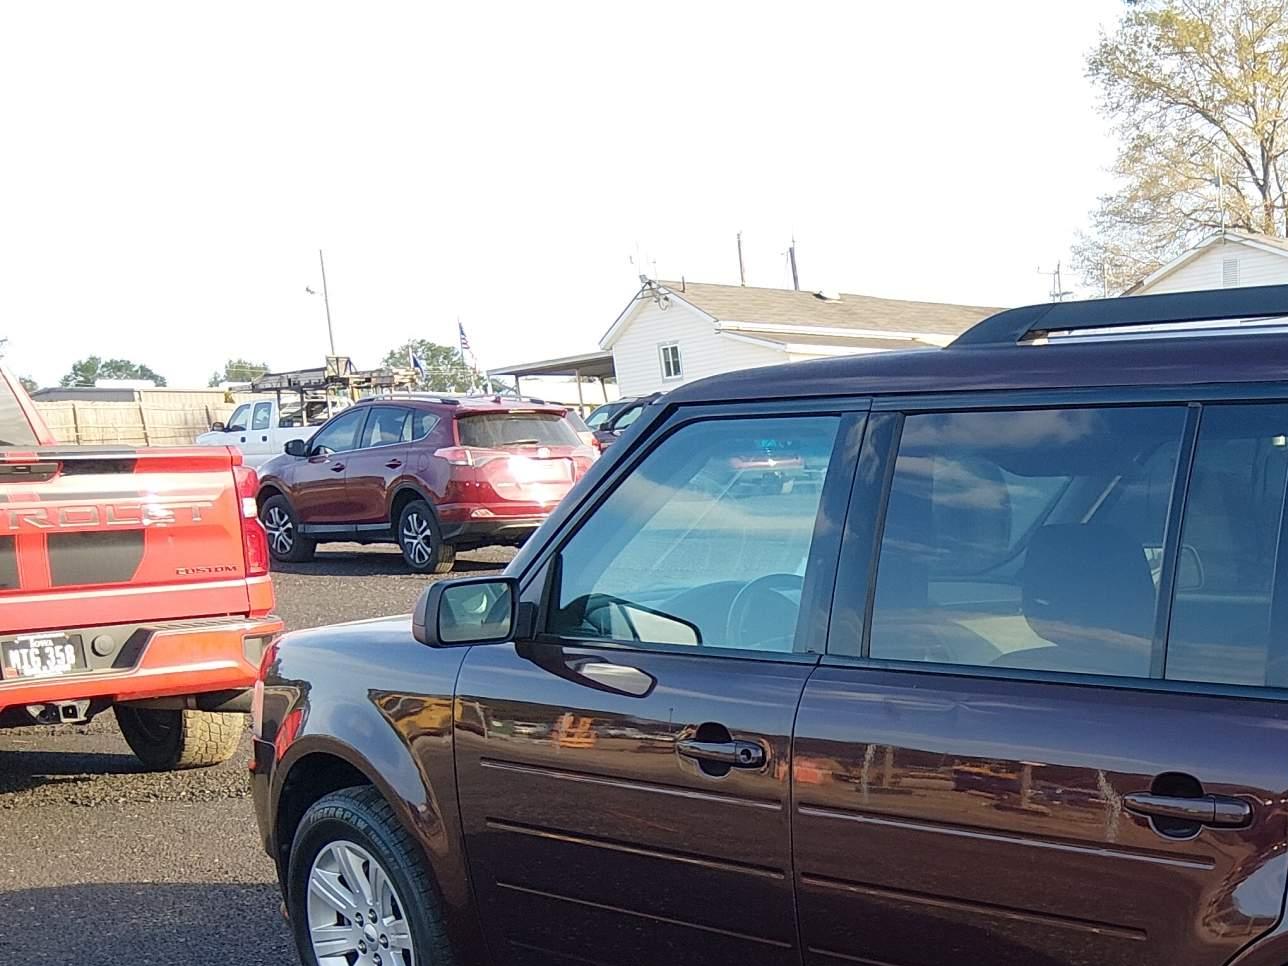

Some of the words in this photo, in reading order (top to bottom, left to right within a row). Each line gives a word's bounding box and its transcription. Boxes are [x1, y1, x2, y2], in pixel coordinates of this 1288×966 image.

[0, 500, 213, 530] ROLET
[175, 565, 238, 576] CUSTOM
[343, 811, 368, 833] PAW
